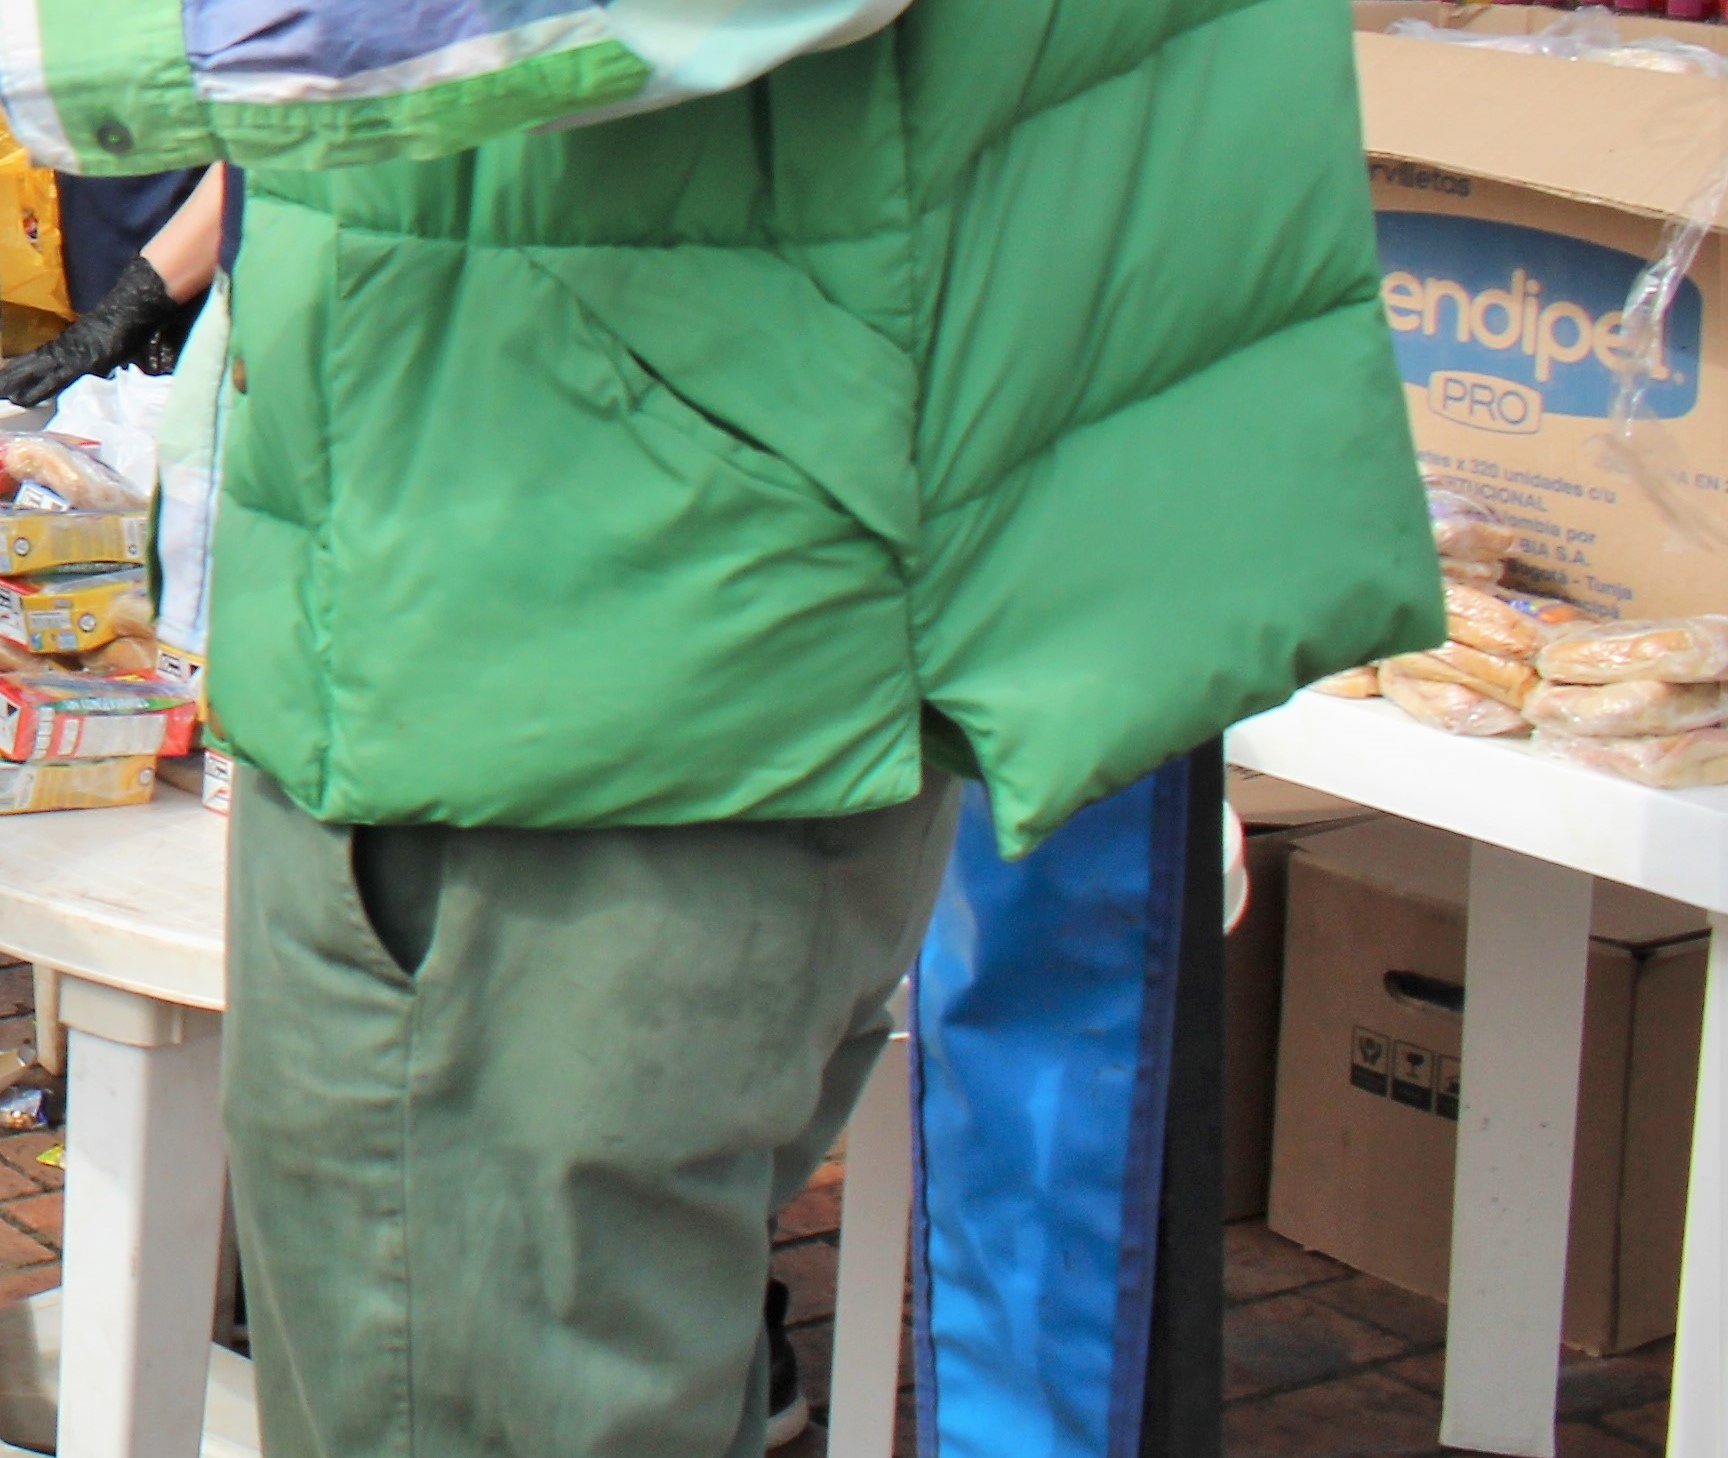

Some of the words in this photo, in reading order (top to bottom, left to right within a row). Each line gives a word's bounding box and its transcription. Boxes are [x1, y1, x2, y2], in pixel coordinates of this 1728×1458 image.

[1442, 376, 1529, 425] PRO
[1504, 467, 1585, 498] unidades
[1566, 526, 1597, 547] por
